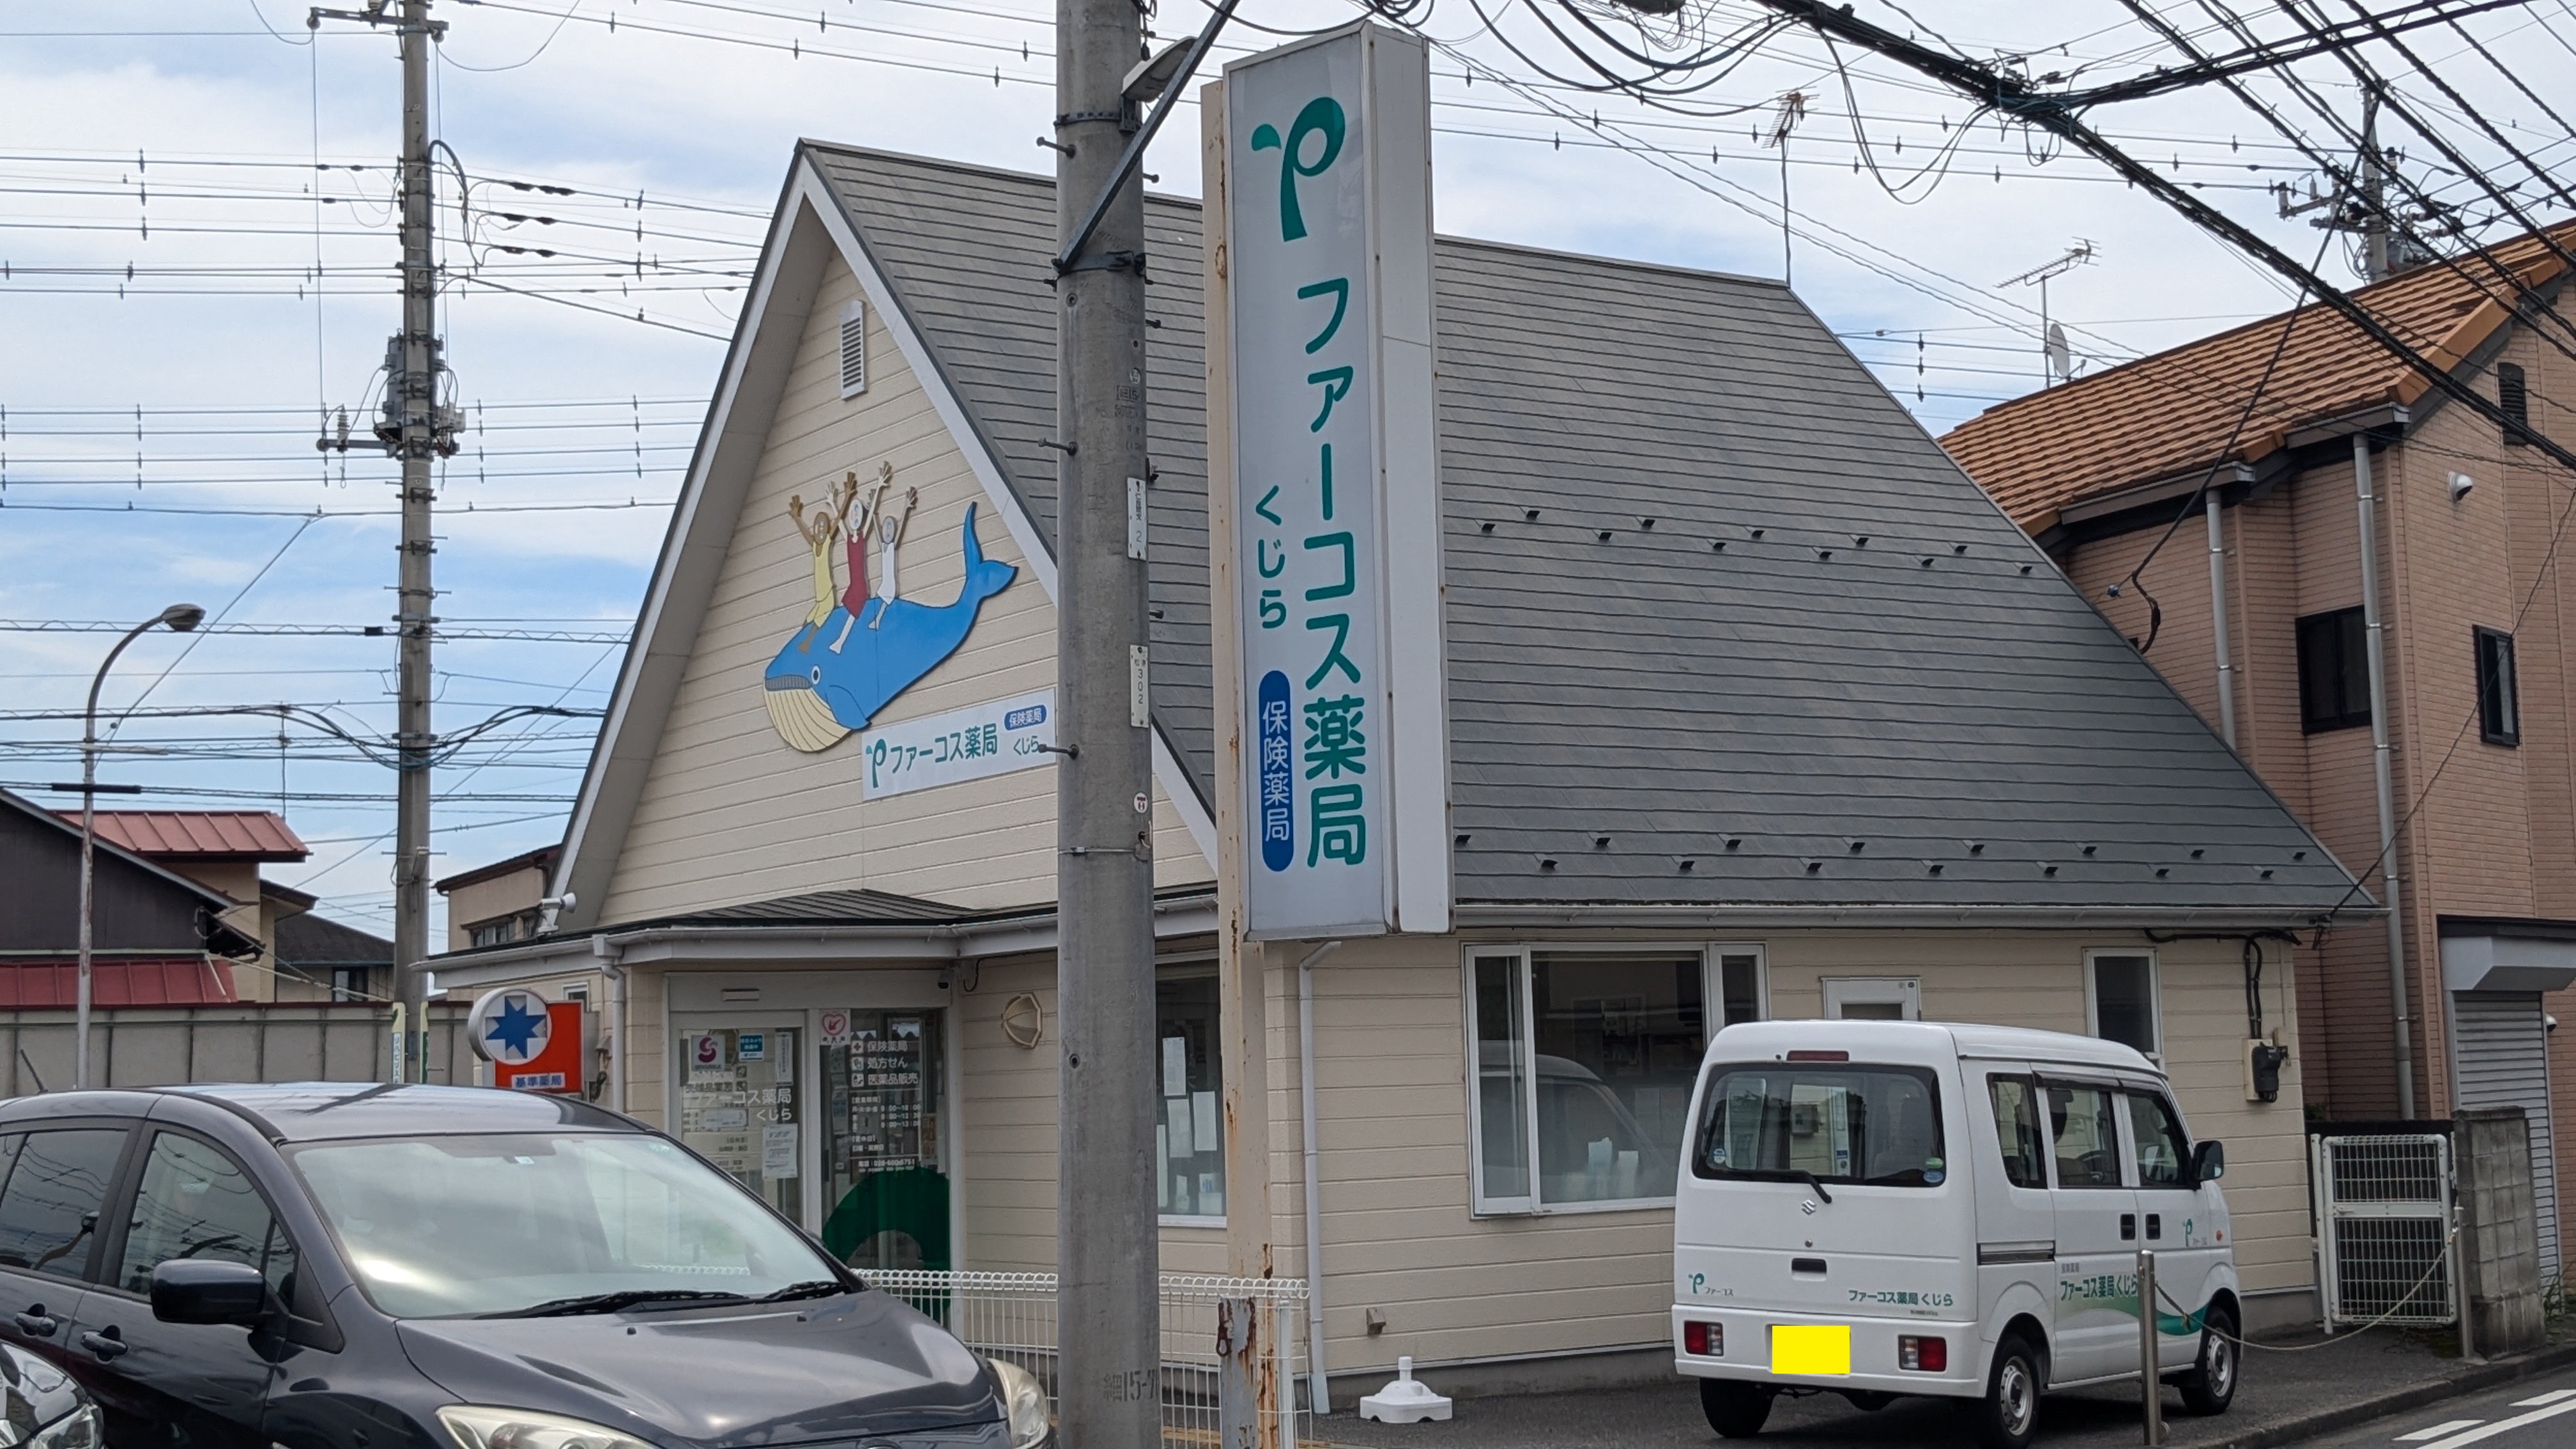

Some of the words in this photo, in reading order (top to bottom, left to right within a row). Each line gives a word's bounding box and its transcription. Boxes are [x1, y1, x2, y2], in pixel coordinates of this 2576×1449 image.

[1255, 484, 1287, 629] くじら
[1297, 277, 1367, 869] ファーコス薬局
[1009, 707, 1042, 728] 保険薬局
[890, 723, 998, 774] ファーコス薬局
[1013, 735, 1040, 756] くじら
[1262, 700, 1291, 842] 保険薬局
[867, 1040, 908, 1052] 保険薬局
[867, 1057, 908, 1069] 処方せん
[516, 1075, 562, 1087] 基準薬局
[868, 1073, 919, 1085] 医薬品販売
[694, 1088, 792, 1105] ファーコス薬局
[756, 1108, 792, 1121] くじら
[1704, 1286, 1733, 1296] ファーコス
[2060, 1275, 2114, 1301] ファーコス薬局
[2117, 1273, 2138, 1296] くじら
[1848, 1289, 1919, 1306] ファーコス薬局
[1921, 1292, 1954, 1307] くじら
